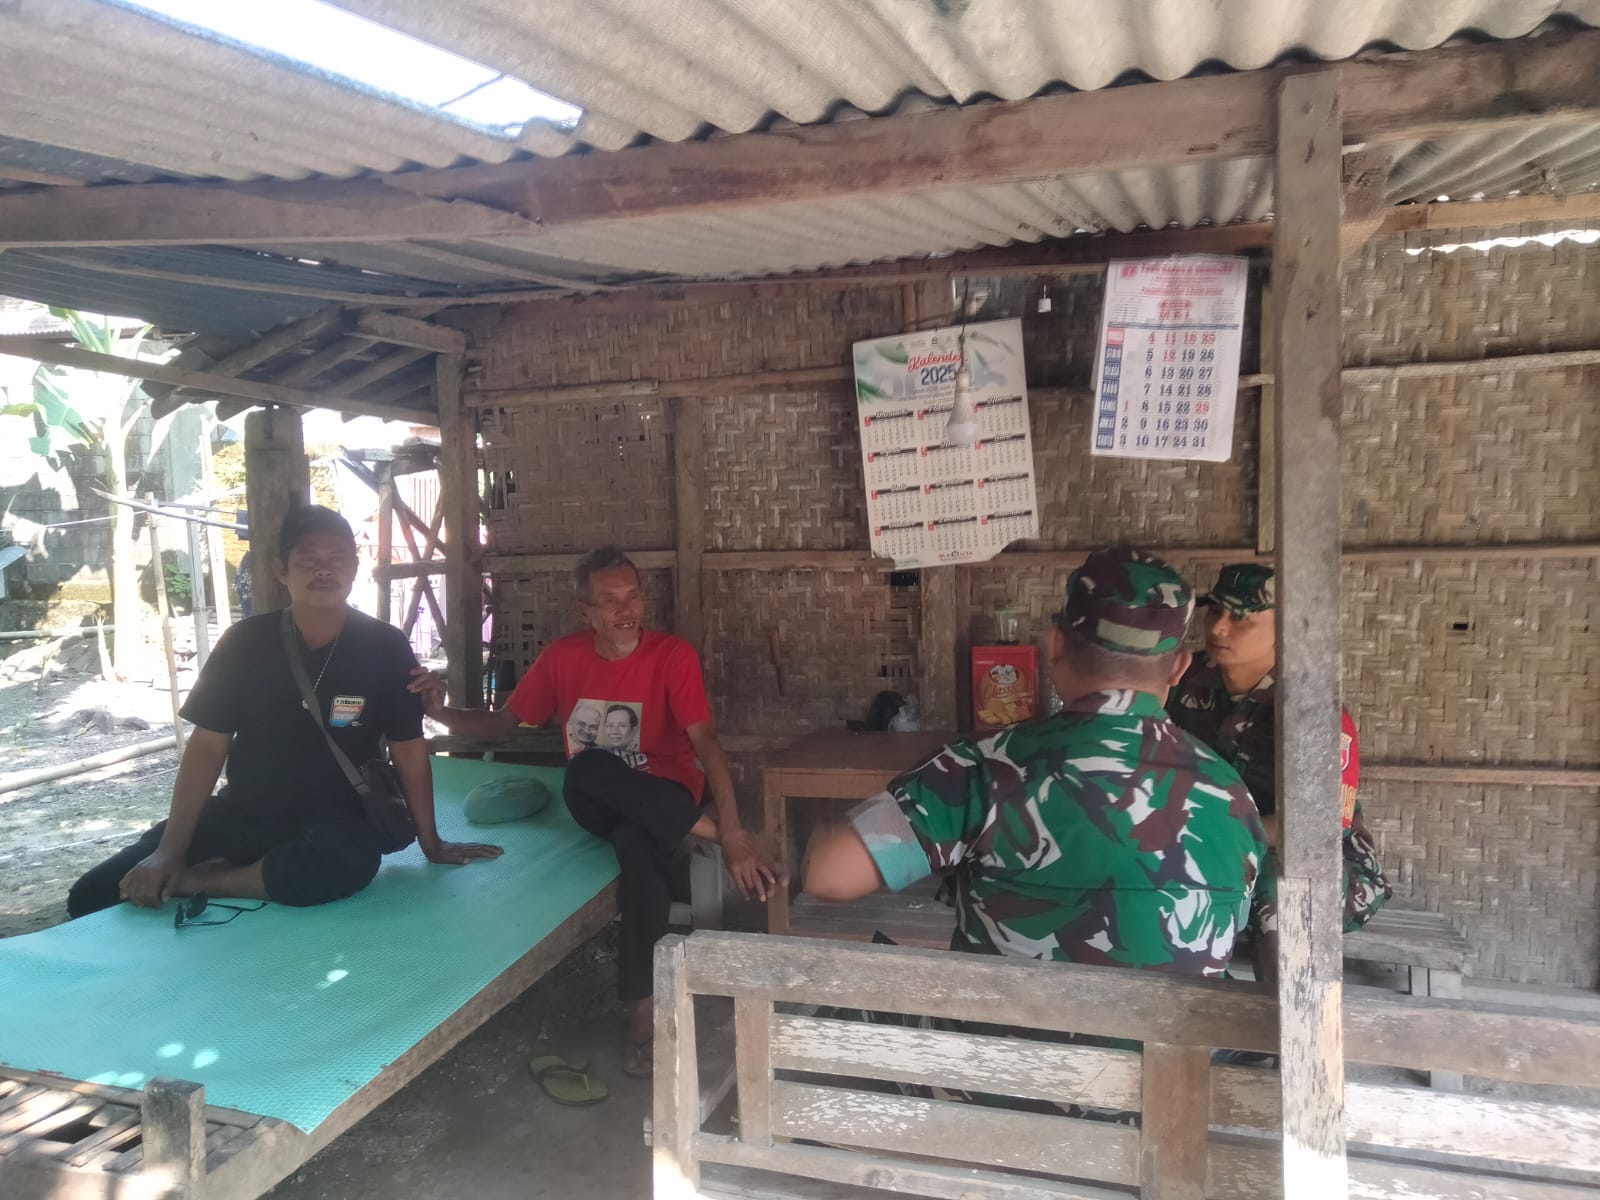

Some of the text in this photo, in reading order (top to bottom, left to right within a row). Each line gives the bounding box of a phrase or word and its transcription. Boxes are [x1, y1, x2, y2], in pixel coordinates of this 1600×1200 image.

[1148, 331, 1156, 344] 4
[1164, 331, 1177, 345] 11
[1201, 331, 1216, 344] 25
[1146, 348, 1153, 362] 5
[1163, 349, 1177, 362] 12
[1182, 348, 1195, 362] 19
[1199, 348, 1214, 362] 26
[920, 363, 957, 386] 2025
[1145, 366, 1152, 379] 6
[1161, 366, 1174, 380] 13
[1179, 366, 1194, 380] 20
[1198, 366, 1213, 380] 27
[1143, 383, 1151, 395] 7
[1160, 383, 1173, 397] 14
[1177, 383, 1191, 397] 21
[1123, 400, 1128, 413] 1
[1142, 400, 1149, 413] 8
[1158, 401, 1171, 414] 15
[1176, 401, 1190, 414] 22
[1195, 401, 1210, 415] 29
[1121, 416, 1128, 429] 2
[1139, 417, 1147, 431] 9
[1156, 418, 1170, 431] 16
[1174, 418, 1188, 432] 23
[1193, 418, 1208, 432] 30
[1119, 433, 1127, 446] 3
[1136, 433, 1149, 447] 10
[1154, 434, 1169, 447] 17
[1172, 434, 1187, 448] 24
[1191, 434, 1206, 448] 31
